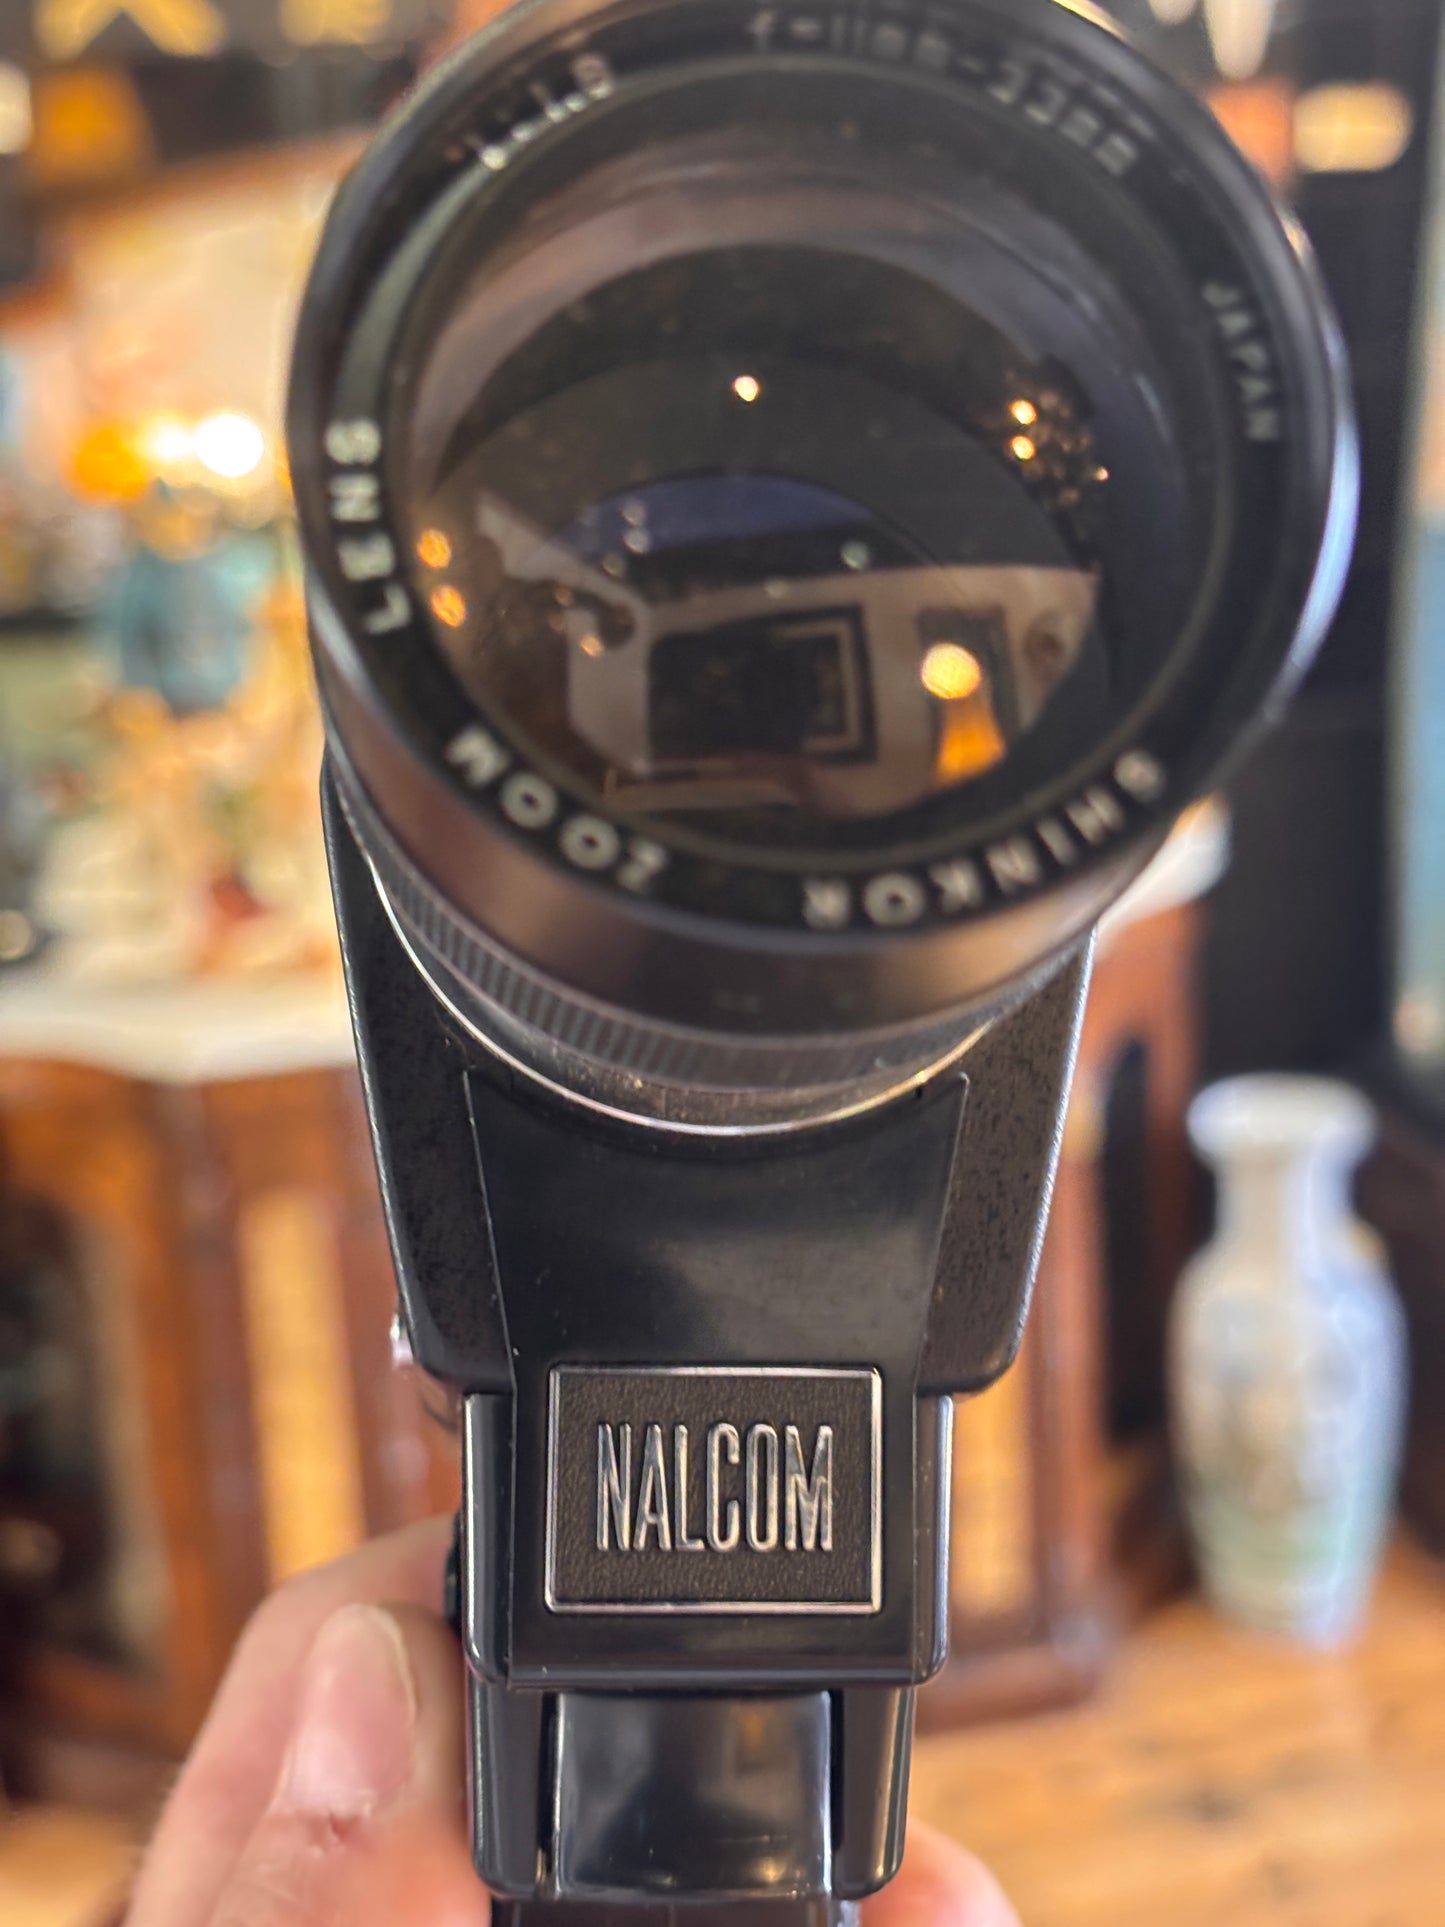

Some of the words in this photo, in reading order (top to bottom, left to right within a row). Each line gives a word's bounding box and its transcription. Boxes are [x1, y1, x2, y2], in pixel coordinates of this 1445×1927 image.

[1201, 280, 1280, 442] JAPAN
[324, 417, 412, 636] LENS
[447, 726, 668, 893] ZOOM
[804, 749, 1168, 931] SHINKOR
[596, 1422, 834, 1553] NALCOM
